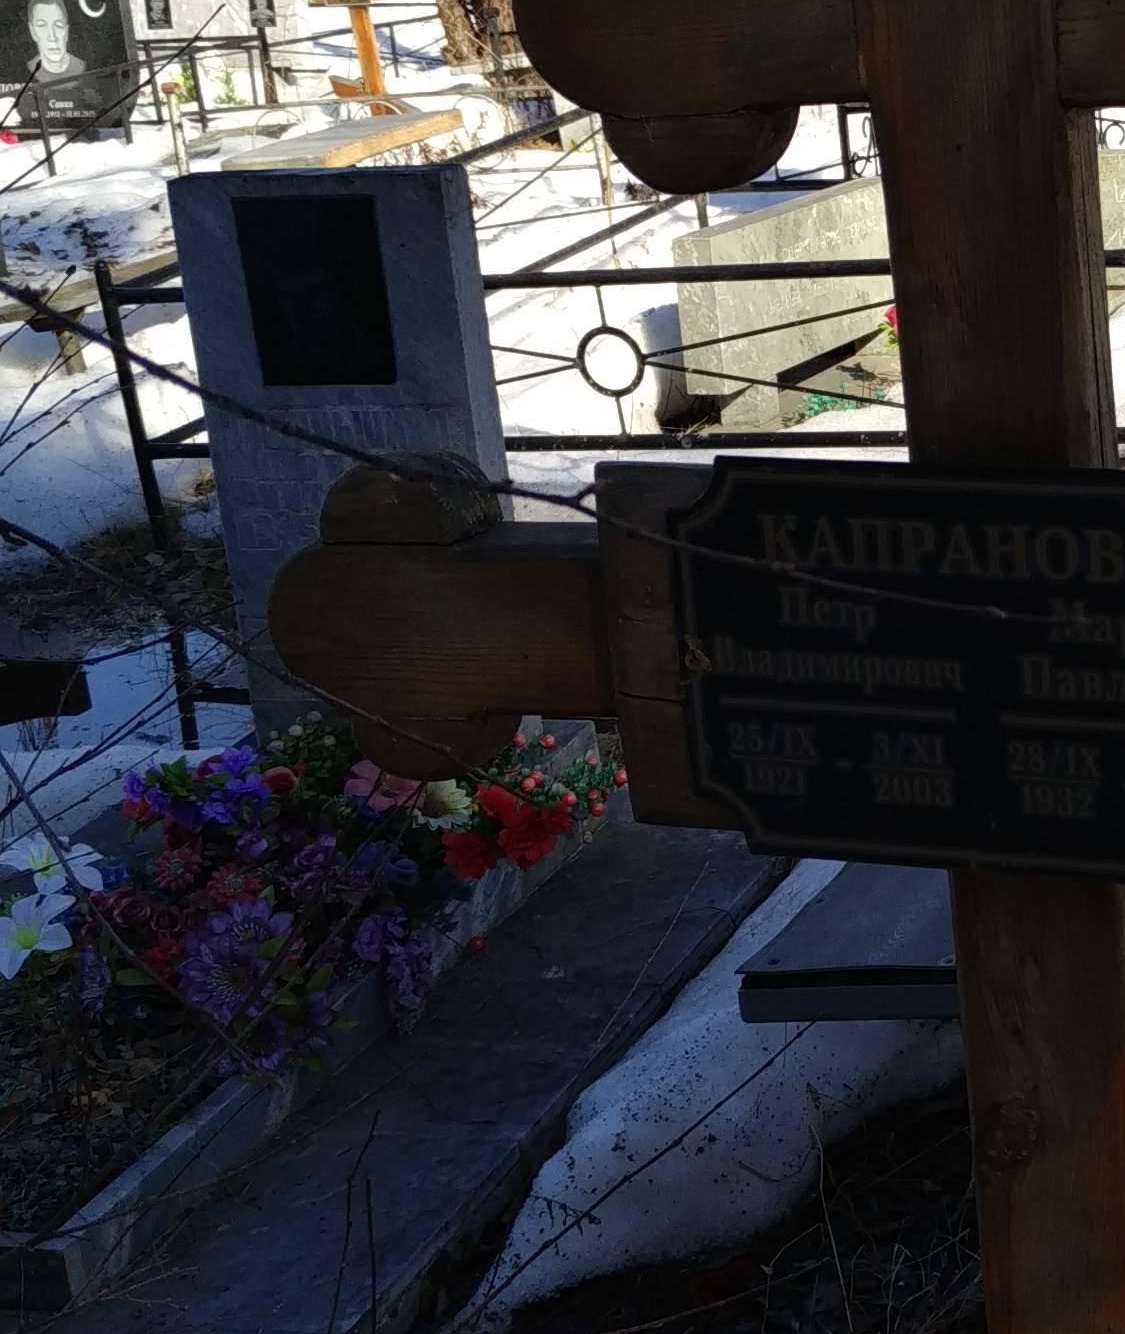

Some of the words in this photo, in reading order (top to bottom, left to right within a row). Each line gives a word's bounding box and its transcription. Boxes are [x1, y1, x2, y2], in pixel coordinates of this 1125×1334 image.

[779, 584, 877, 644] Петр
[713, 634, 965, 696] Владимирович
[874, 776, 955, 808] 2003
